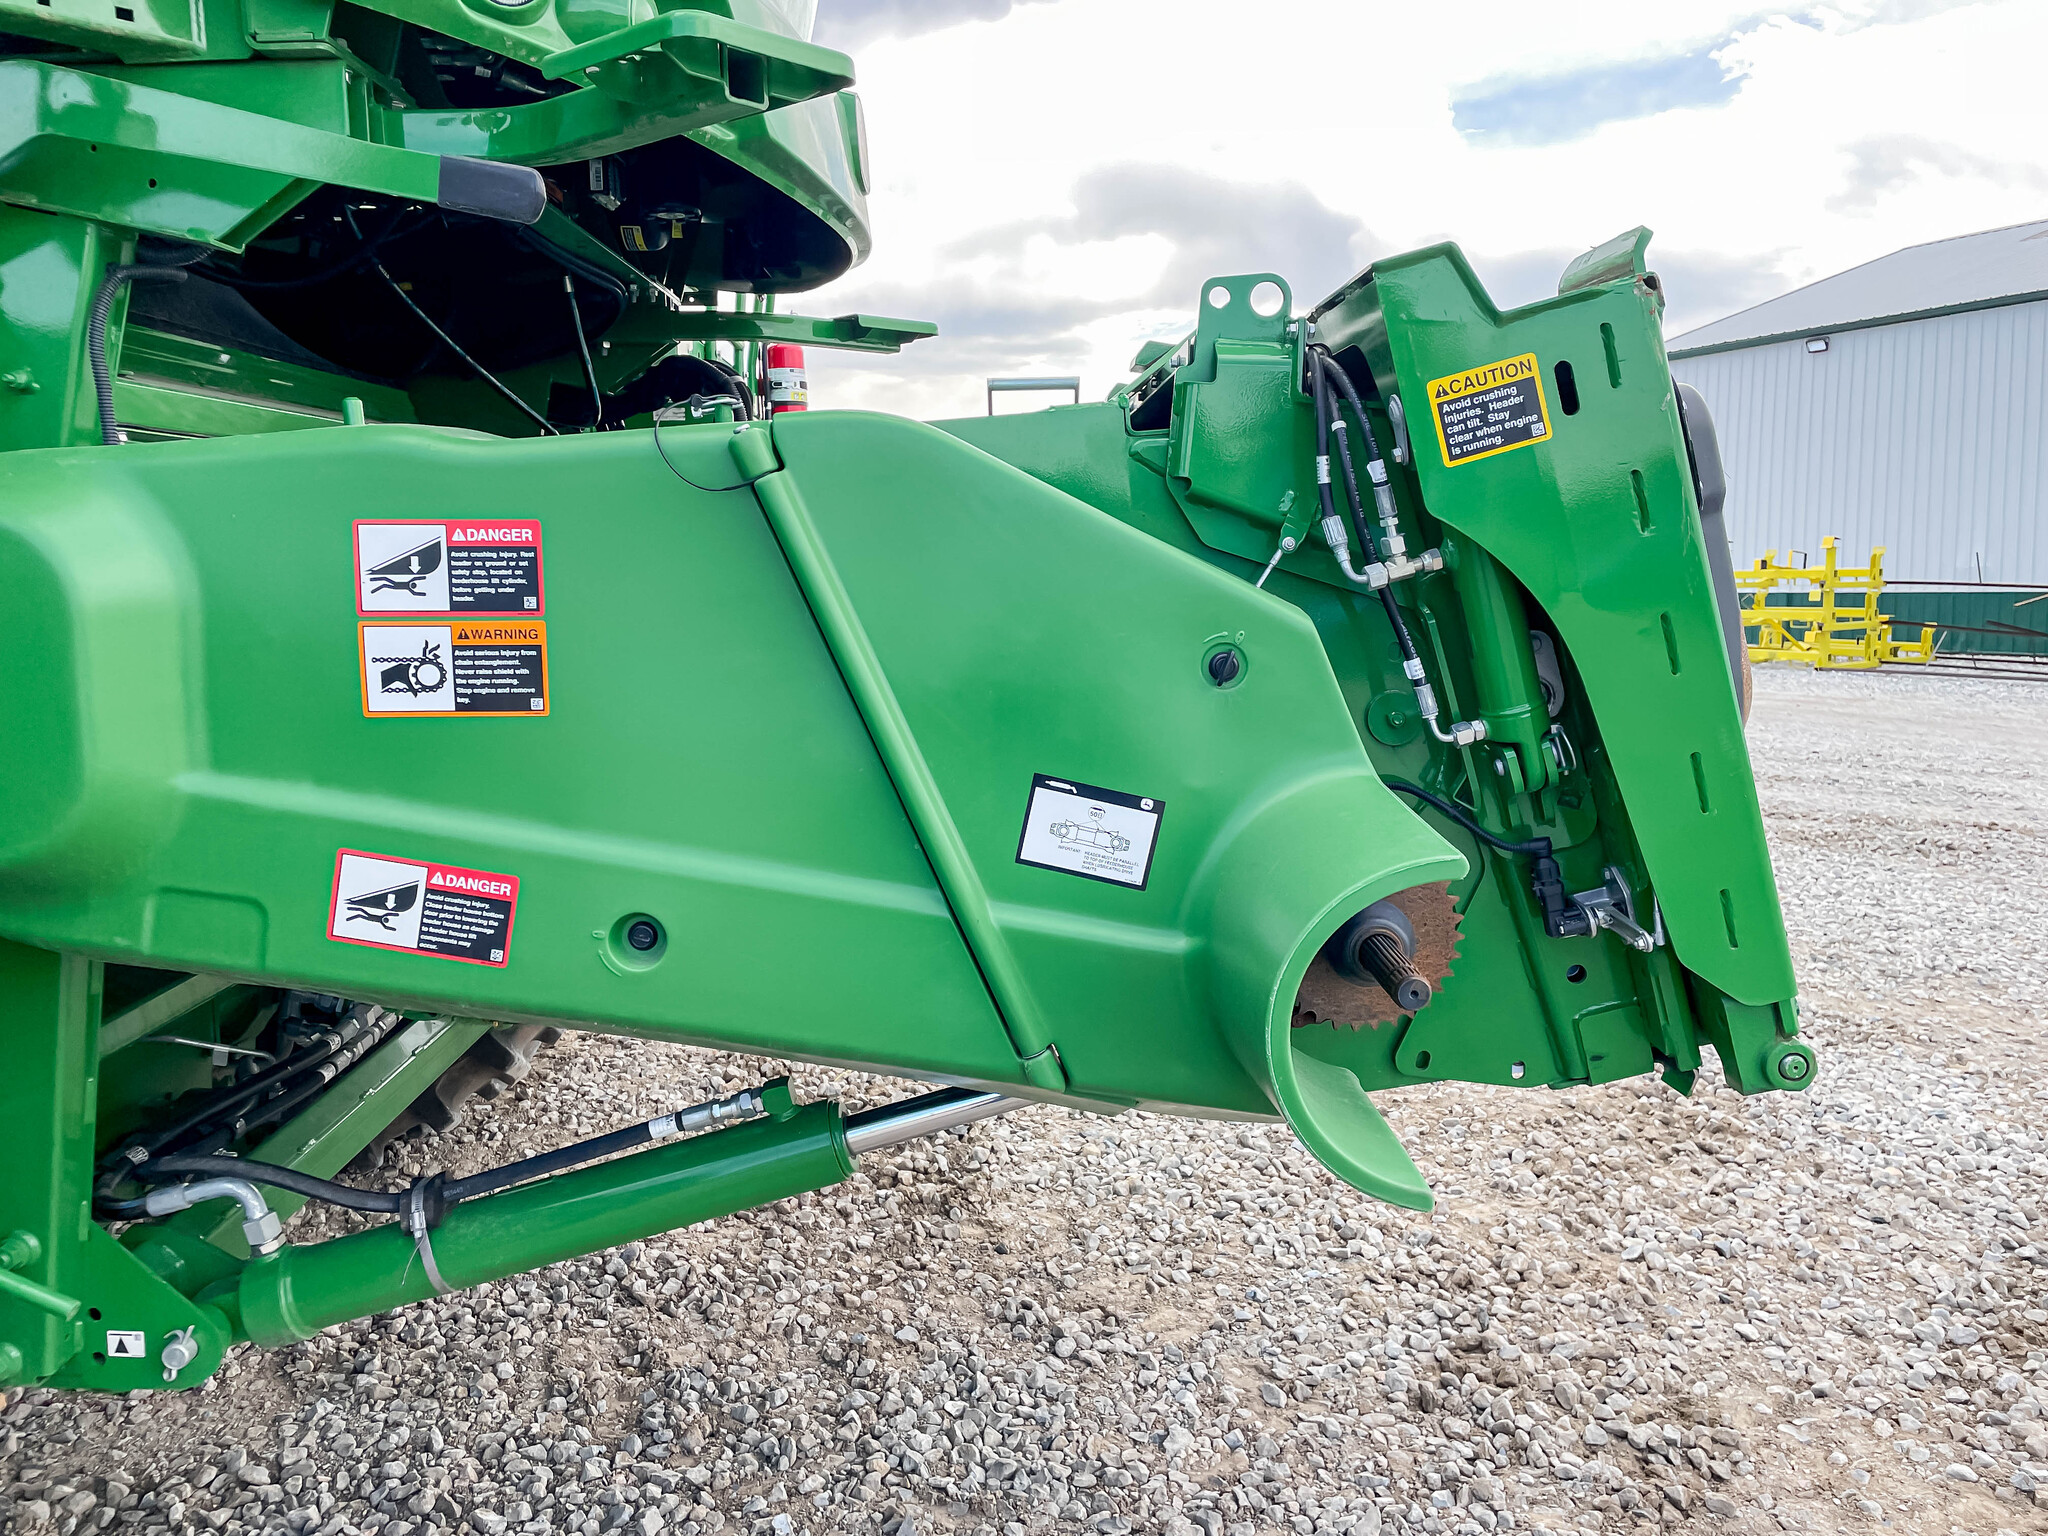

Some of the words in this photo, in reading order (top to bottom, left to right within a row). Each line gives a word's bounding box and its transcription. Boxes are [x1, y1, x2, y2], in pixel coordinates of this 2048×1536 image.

[1449, 359, 1532, 393] CAUTION
[1443, 399, 1471, 413] Avoid
[1474, 386, 1517, 404] crushing
[1445, 408, 1484, 424] injuries.
[1489, 395, 1524, 411] Header
[1447, 423, 1465, 434] can
[1467, 419, 1483, 428] tilt.
[1488, 410, 1510, 422] Stay
[1449, 432, 1473, 444] clear
[1476, 424, 1502, 437] when
[1504, 414, 1538, 429] engine
[1452, 447, 1461, 455] is
[1463, 435, 1504, 452] running.
[466, 529, 532, 541] DANGER
[471, 629, 538, 639] WARNING
[445, 874, 511, 896] DANGER
[445, 896, 471, 906] crushing
[444, 904, 462, 912] feeder
[483, 911, 504, 919] bottom
[462, 916, 487, 925] lowering
[449, 930, 467, 938] house
[471, 926, 494, 934] damage
[421, 935, 457, 944] components
